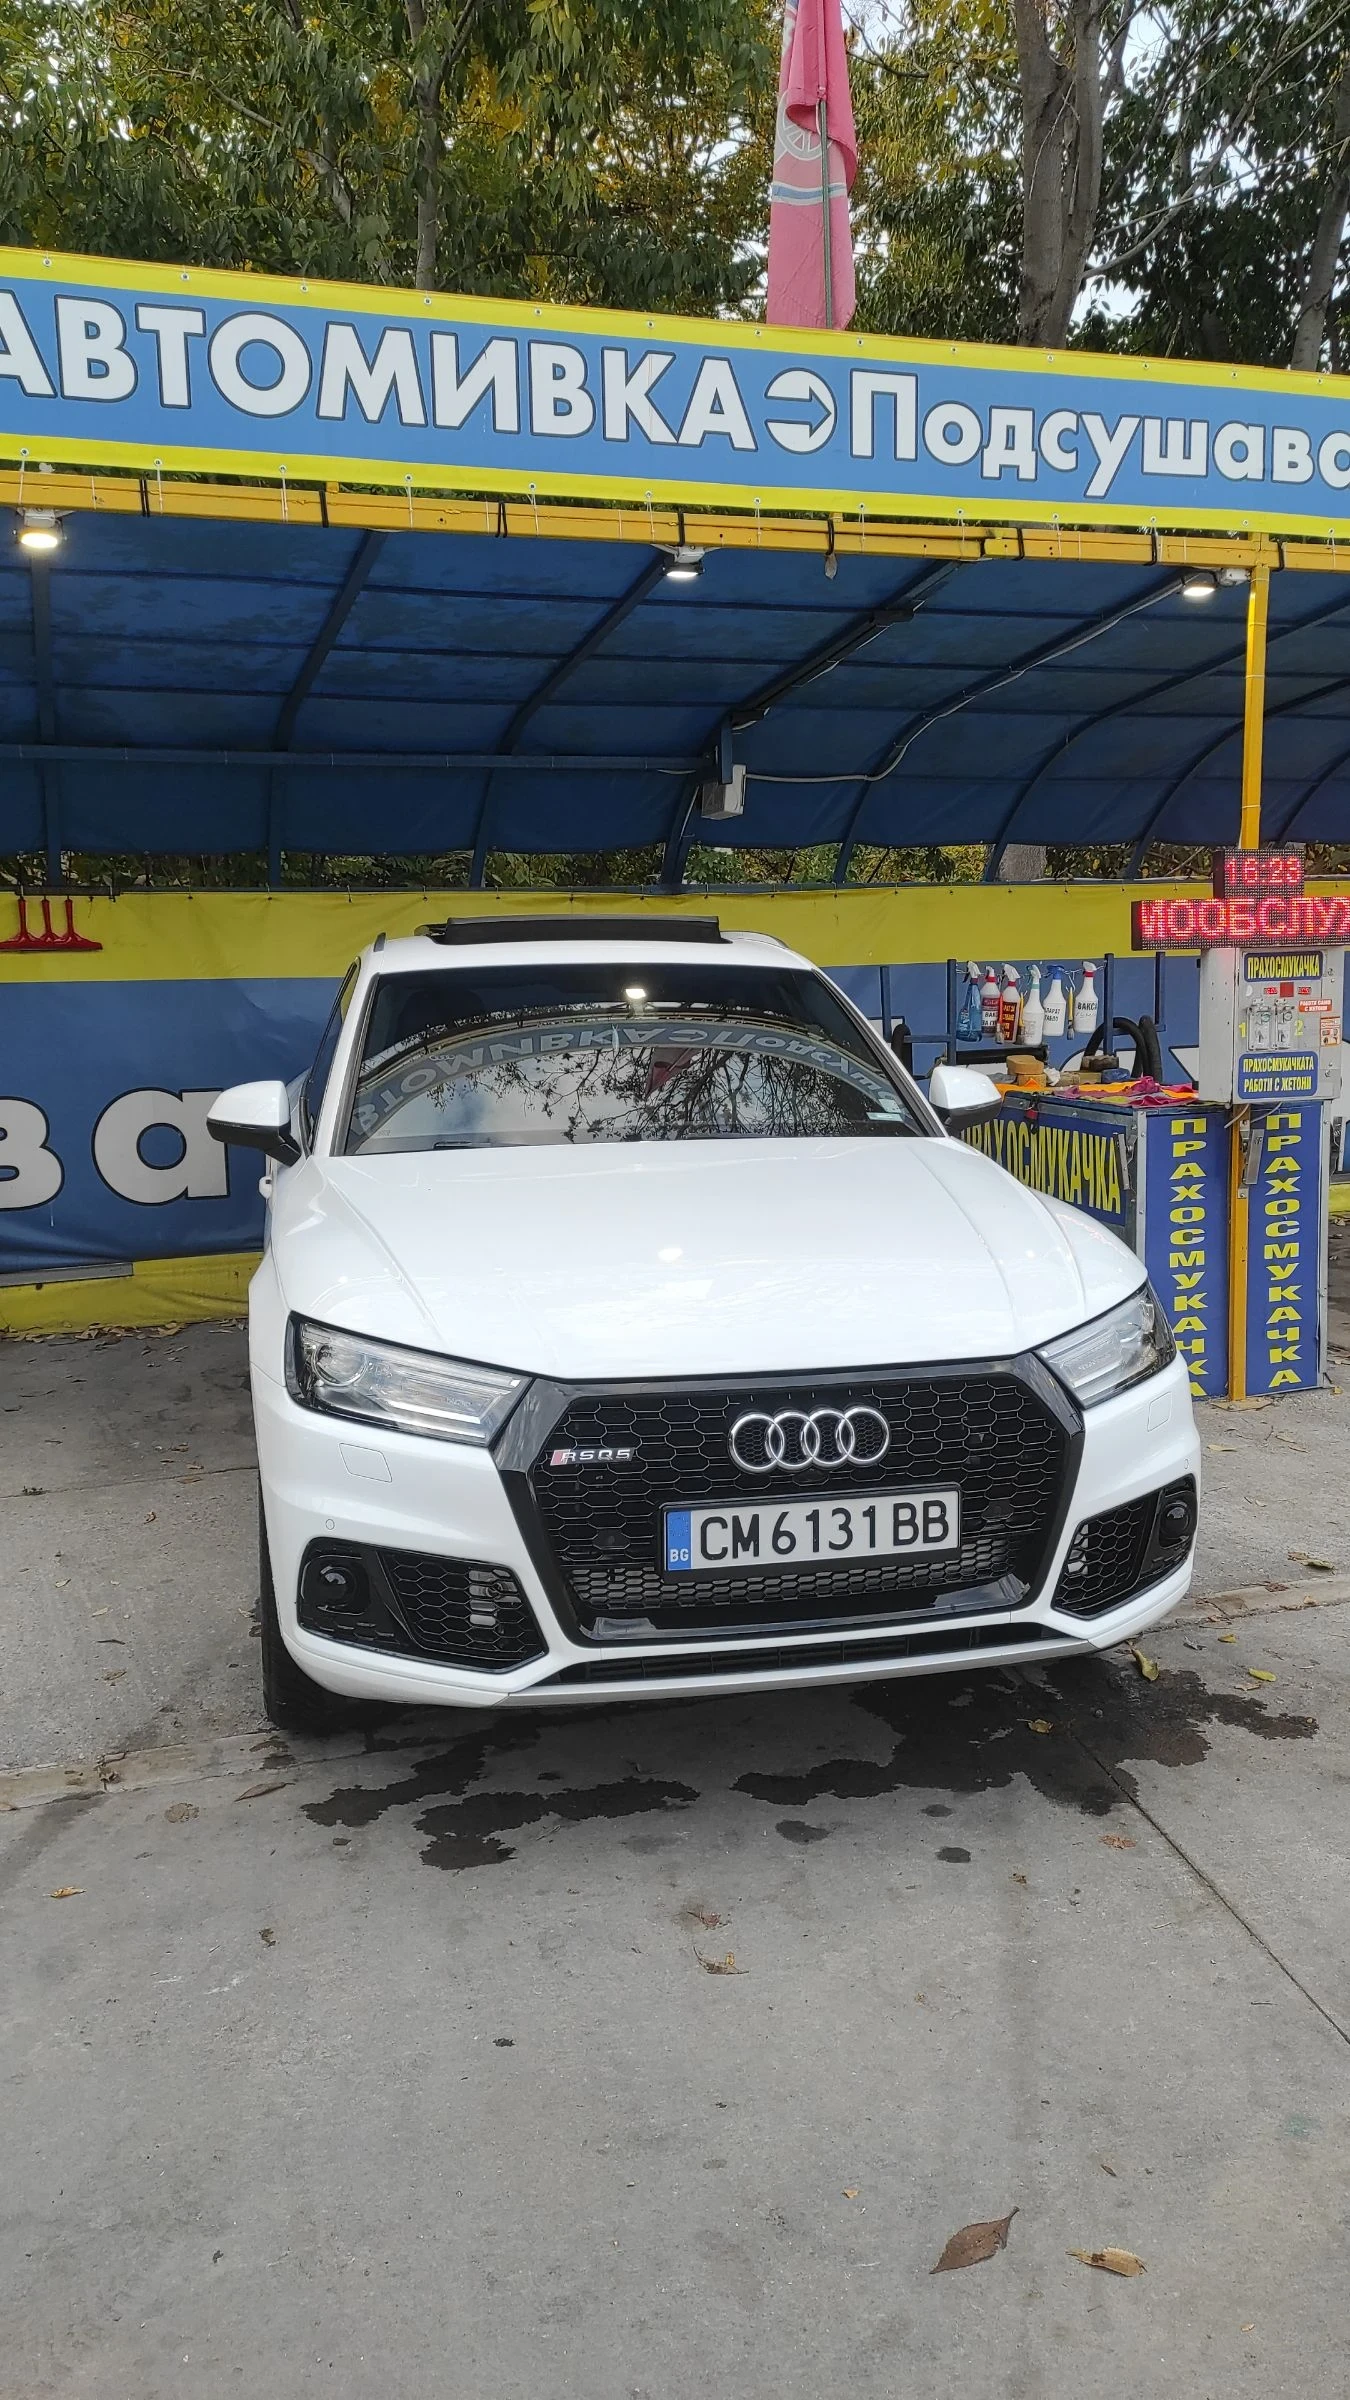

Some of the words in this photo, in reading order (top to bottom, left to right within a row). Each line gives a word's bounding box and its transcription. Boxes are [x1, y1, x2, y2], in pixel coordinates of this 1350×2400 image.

[1247, 954, 1320, 979] ПРАХОСМУКАЧКА
[1243, 1056, 1315, 1073] ПРАХОСМУКАЧКАТА
[1243, 1077, 1273, 1093] РАБОТИ
[1274, 1077, 1280, 1091] С
[1281, 1076, 1312, 1091] ЖЕТОНИ
[1264, 1113, 1302, 1388] ПРАХОСМУКАЧКА
[560, 1448, 631, 1462] RSQ5
[669, 1548, 689, 1563] BG
